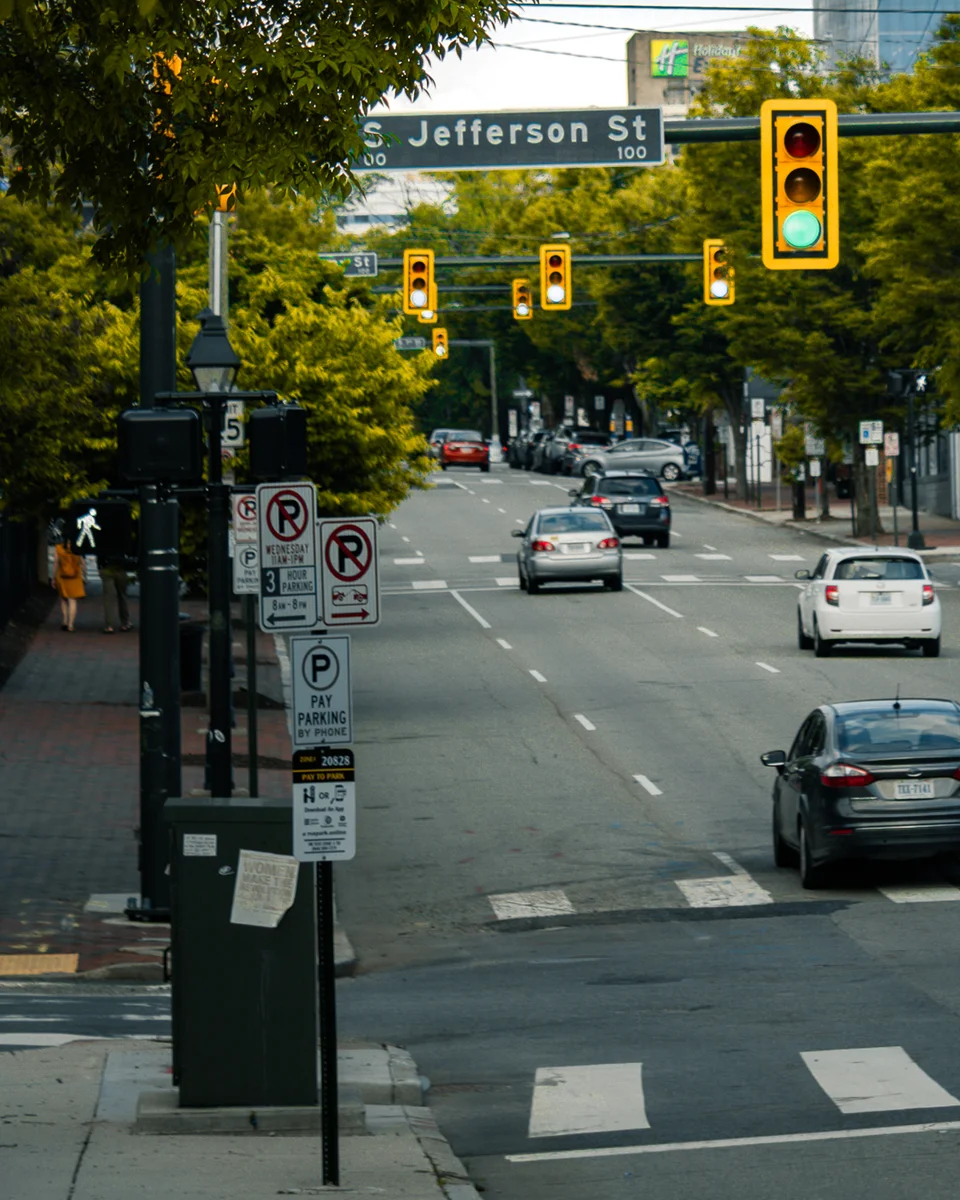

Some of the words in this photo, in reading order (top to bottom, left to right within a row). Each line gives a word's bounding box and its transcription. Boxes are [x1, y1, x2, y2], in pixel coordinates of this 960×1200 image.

[363, 121, 383, 148] S
[408, 118, 588, 147] Jefferson
[608, 114, 647, 141] St
[617, 146, 647, 160] 100
[353, 256, 370, 267] St
[265, 544, 309, 555] WEDNESDAY
[271, 555, 304, 565] 11AM-1PM
[287, 569, 307, 580] HOUR
[265, 570, 276, 593] 3
[282, 581, 313, 592] PARKING
[311, 694, 333, 709] PAY
[298, 710, 347, 726] PARKING
[298, 728, 311, 738] BY
[314, 727, 348, 737] PHONE
[321, 755, 351, 766] 20828
[301, 773, 315, 781] PAY
[326, 772, 345, 780] PARK
[318, 792, 329, 800] OR
[243, 862, 295, 879] WOMEN
